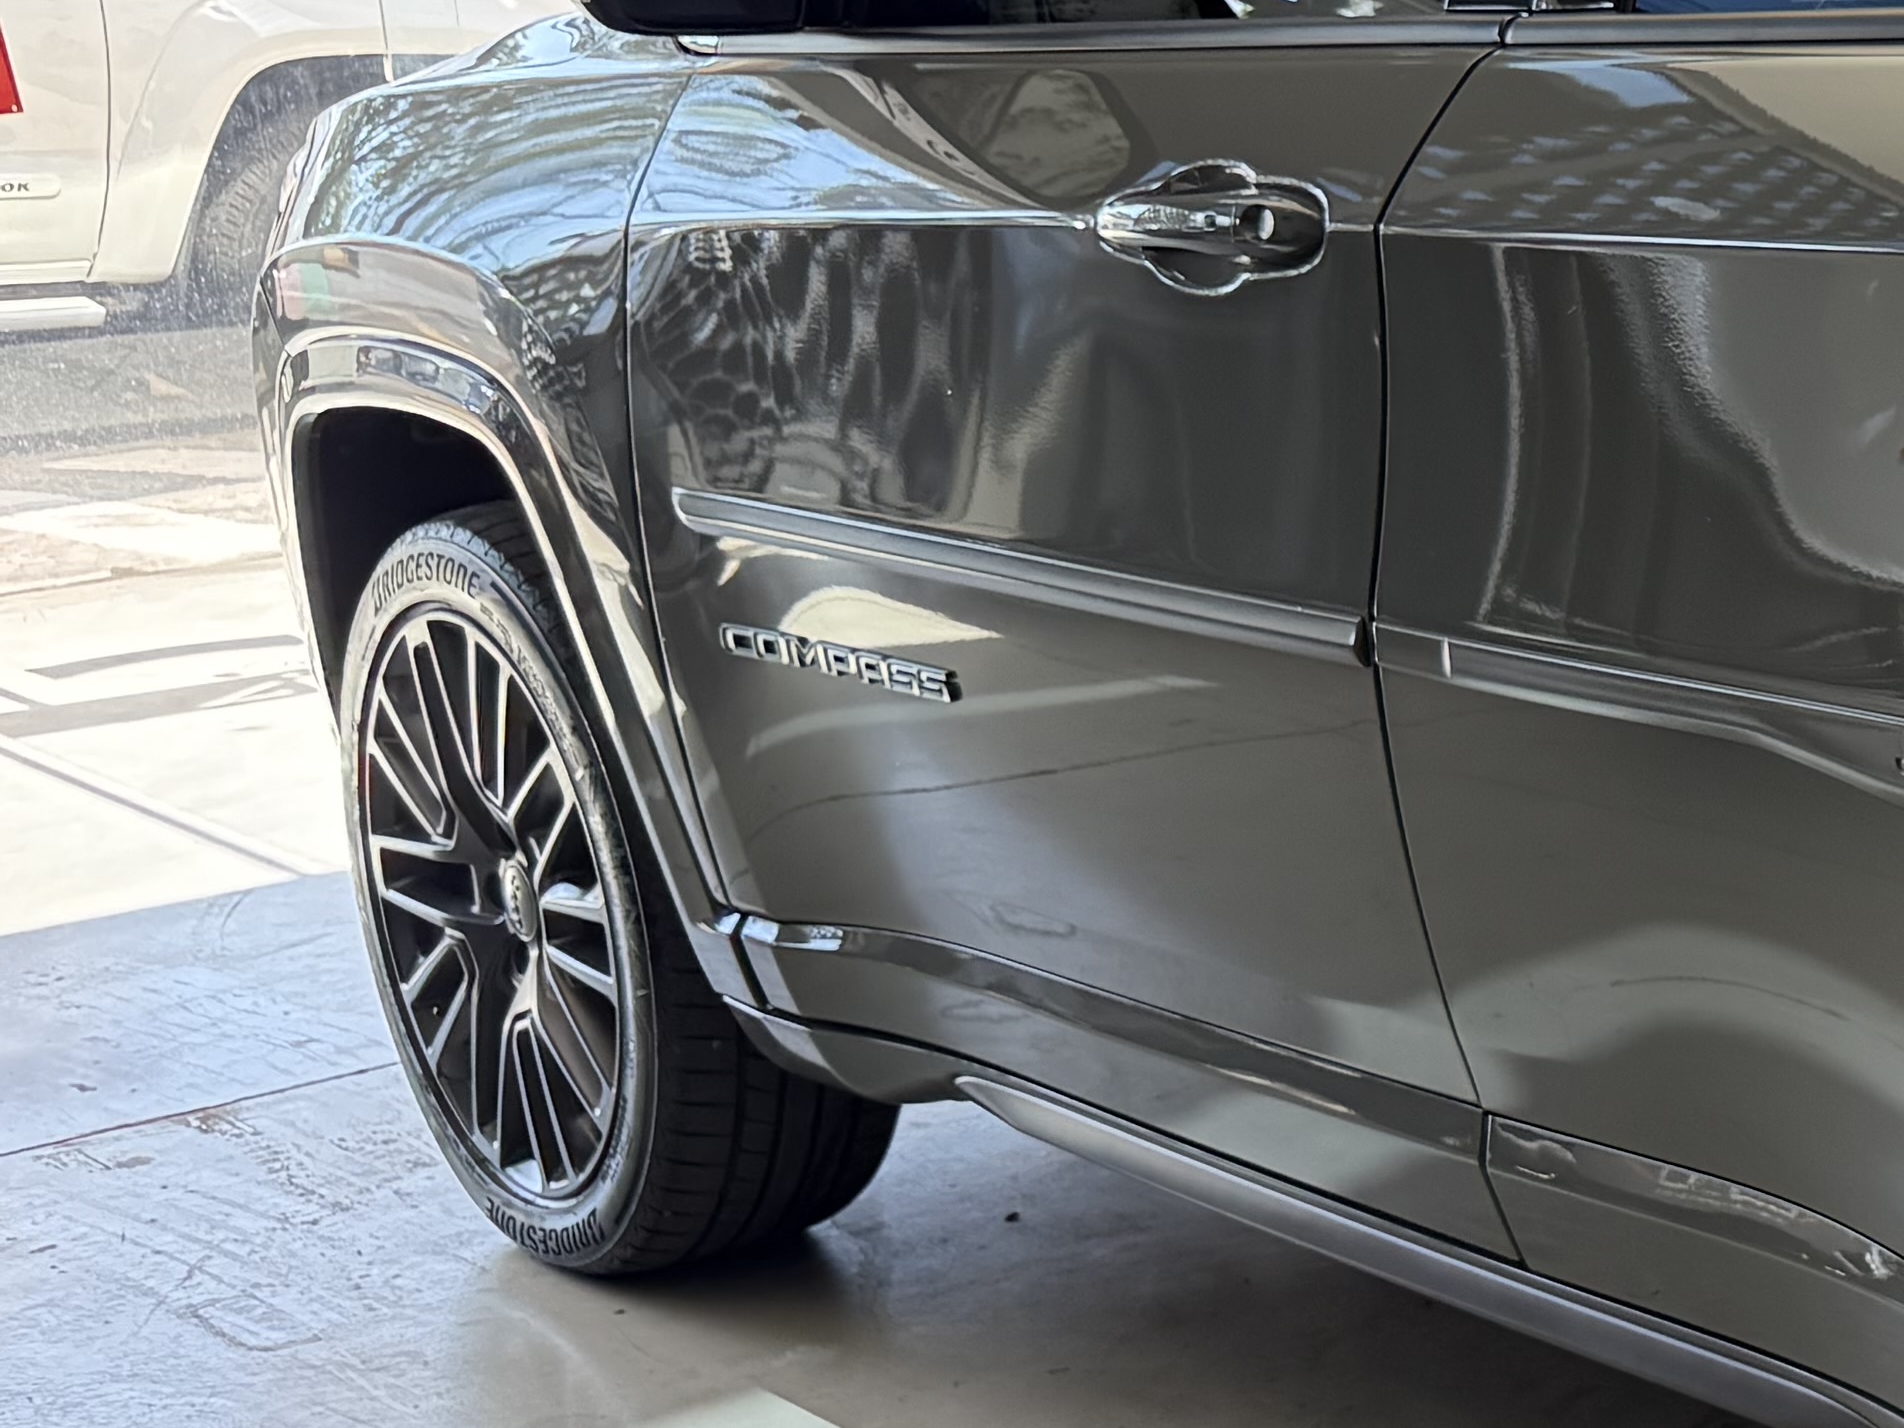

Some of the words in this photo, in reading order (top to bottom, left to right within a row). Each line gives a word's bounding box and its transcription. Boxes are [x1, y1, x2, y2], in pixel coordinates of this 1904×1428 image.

[371, 551, 481, 613] BRIDGESTONE
[718, 622, 964, 704] COMPASS
[484, 1195, 606, 1256] BRIDGESTONE
